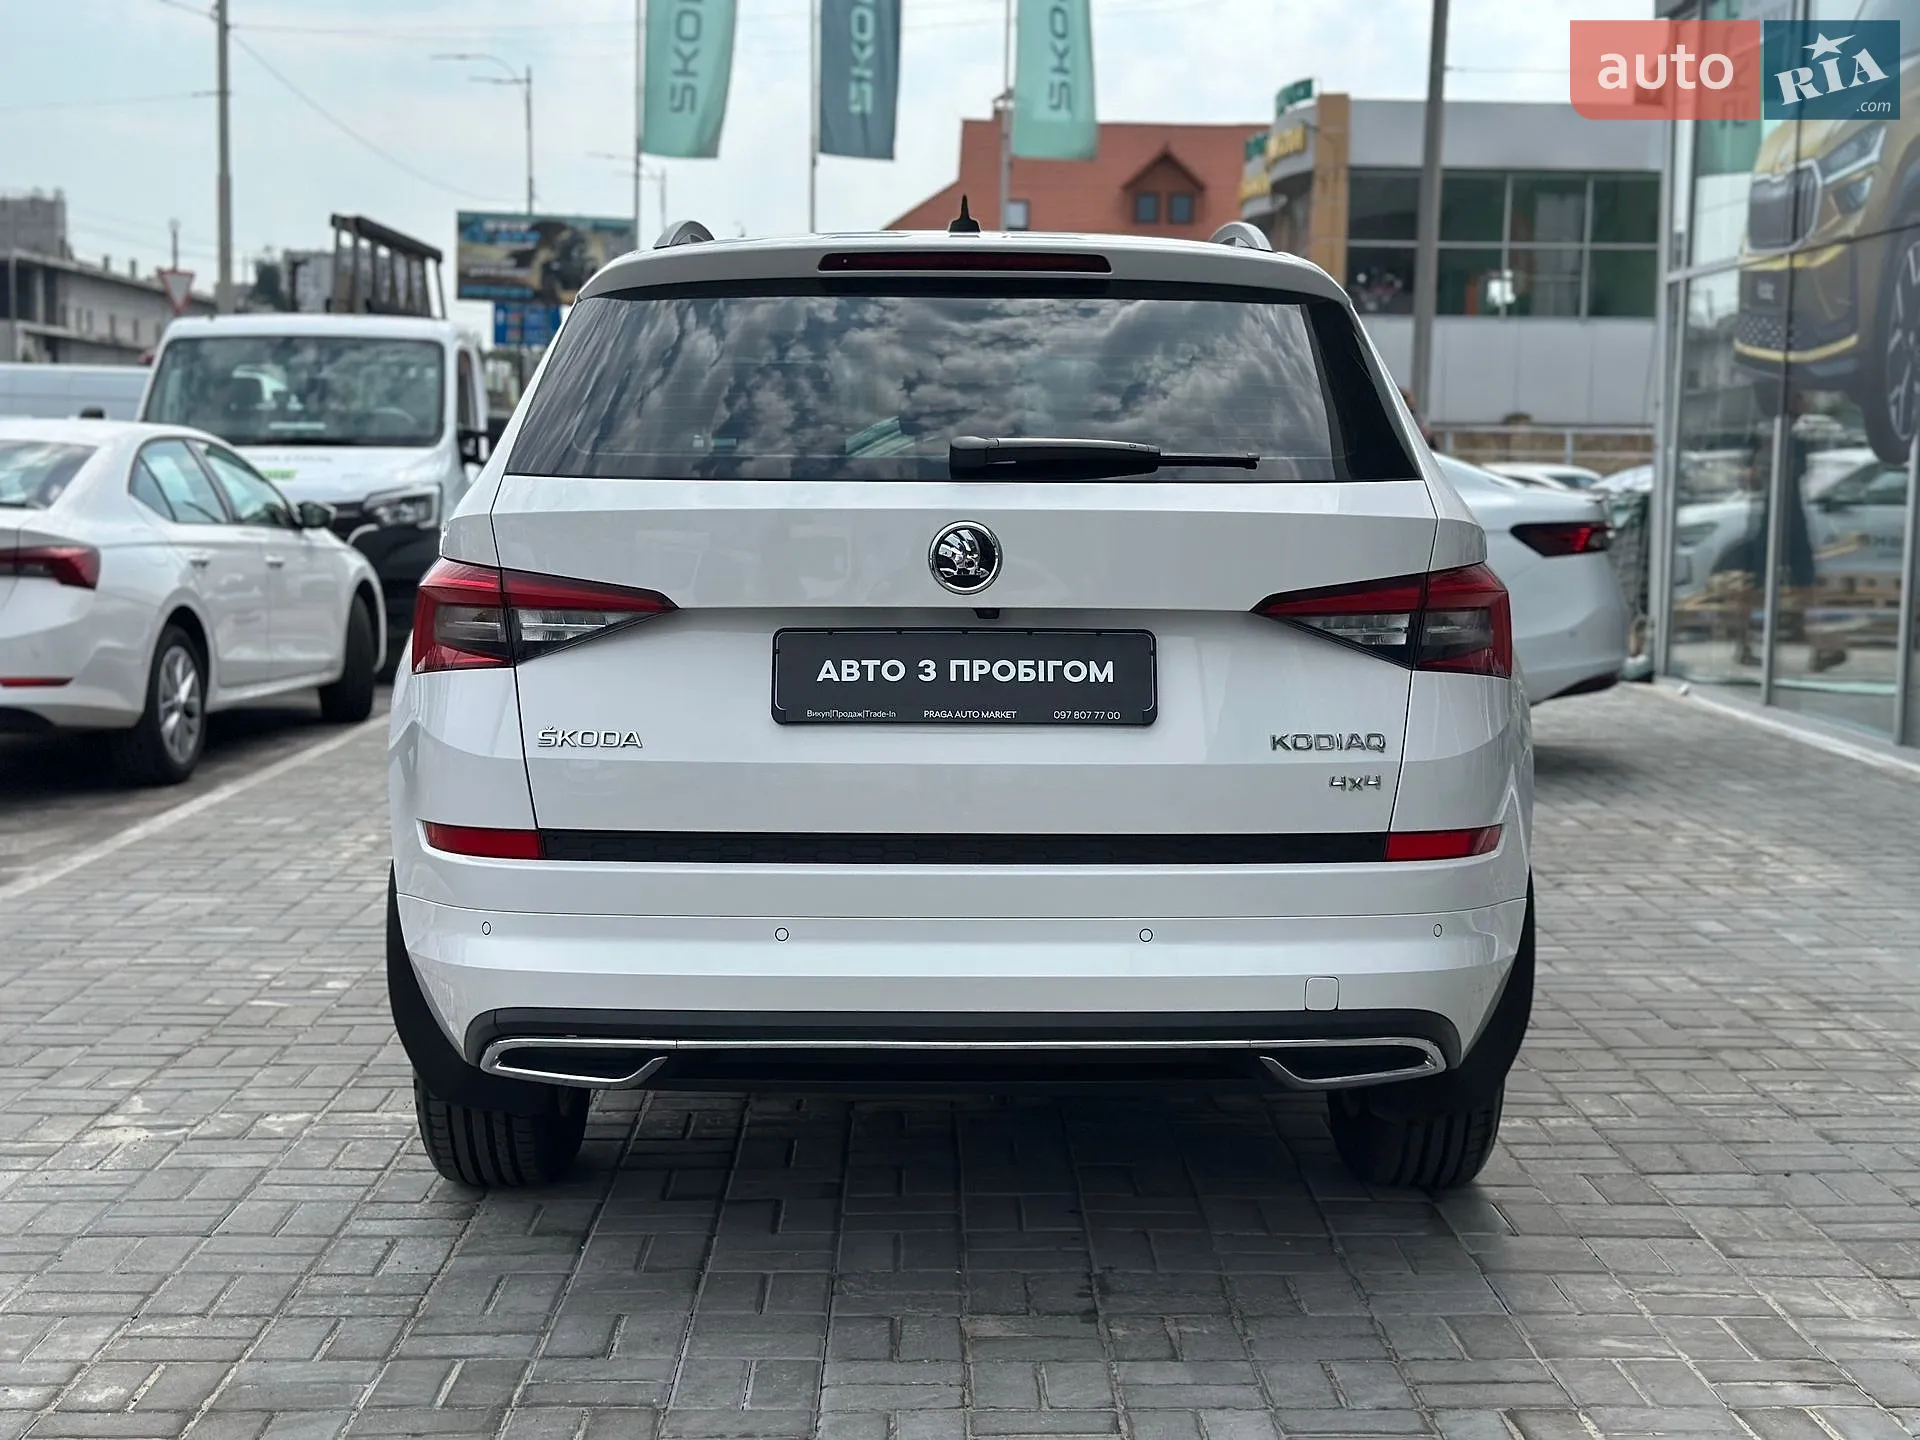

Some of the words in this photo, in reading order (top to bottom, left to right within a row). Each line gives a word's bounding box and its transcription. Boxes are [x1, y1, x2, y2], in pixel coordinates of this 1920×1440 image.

[816, 659, 906, 682] АВТО
[949, 659, 1114, 683] ПРОБІГОМ
[923, 710, 954, 719] PRAGA
[954, 710, 980, 719] AUTO
[981, 710, 1017, 719] MARKET
[1053, 710, 1072, 720] 097
[1073, 711, 1092, 720] 807
[1094, 711, 1105, 720] 77
[1107, 711, 1121, 720] 00
[538, 726, 643, 748] ŠKODA
[1270, 733, 1386, 753] KODIAQ
[1329, 775, 1382, 791] 4x4
